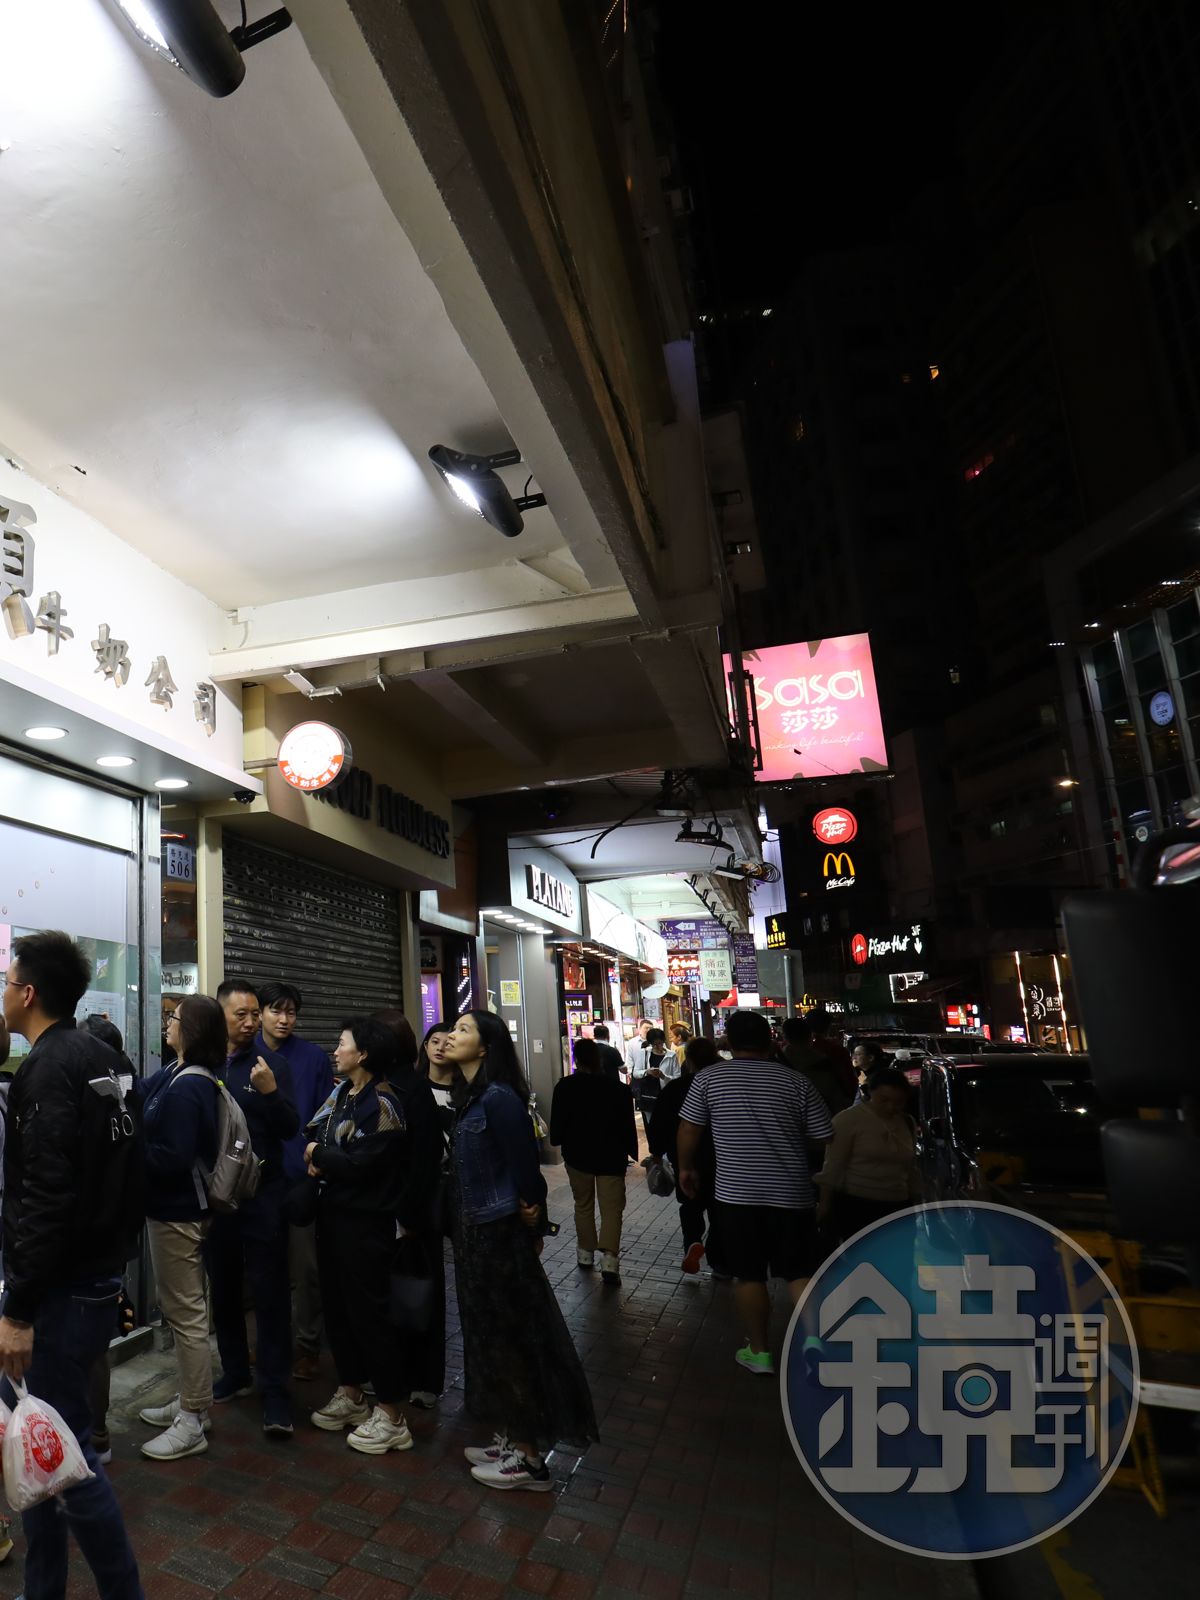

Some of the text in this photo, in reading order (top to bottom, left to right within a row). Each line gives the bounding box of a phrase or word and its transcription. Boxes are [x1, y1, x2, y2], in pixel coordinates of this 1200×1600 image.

[780, 705, 840, 734] 莎莎
[821, 821, 847, 833] Pizza
[826, 827, 847, 839] Hut
[170, 860, 190, 878] 506
[868, 934, 911, 958] Pizza Hut
